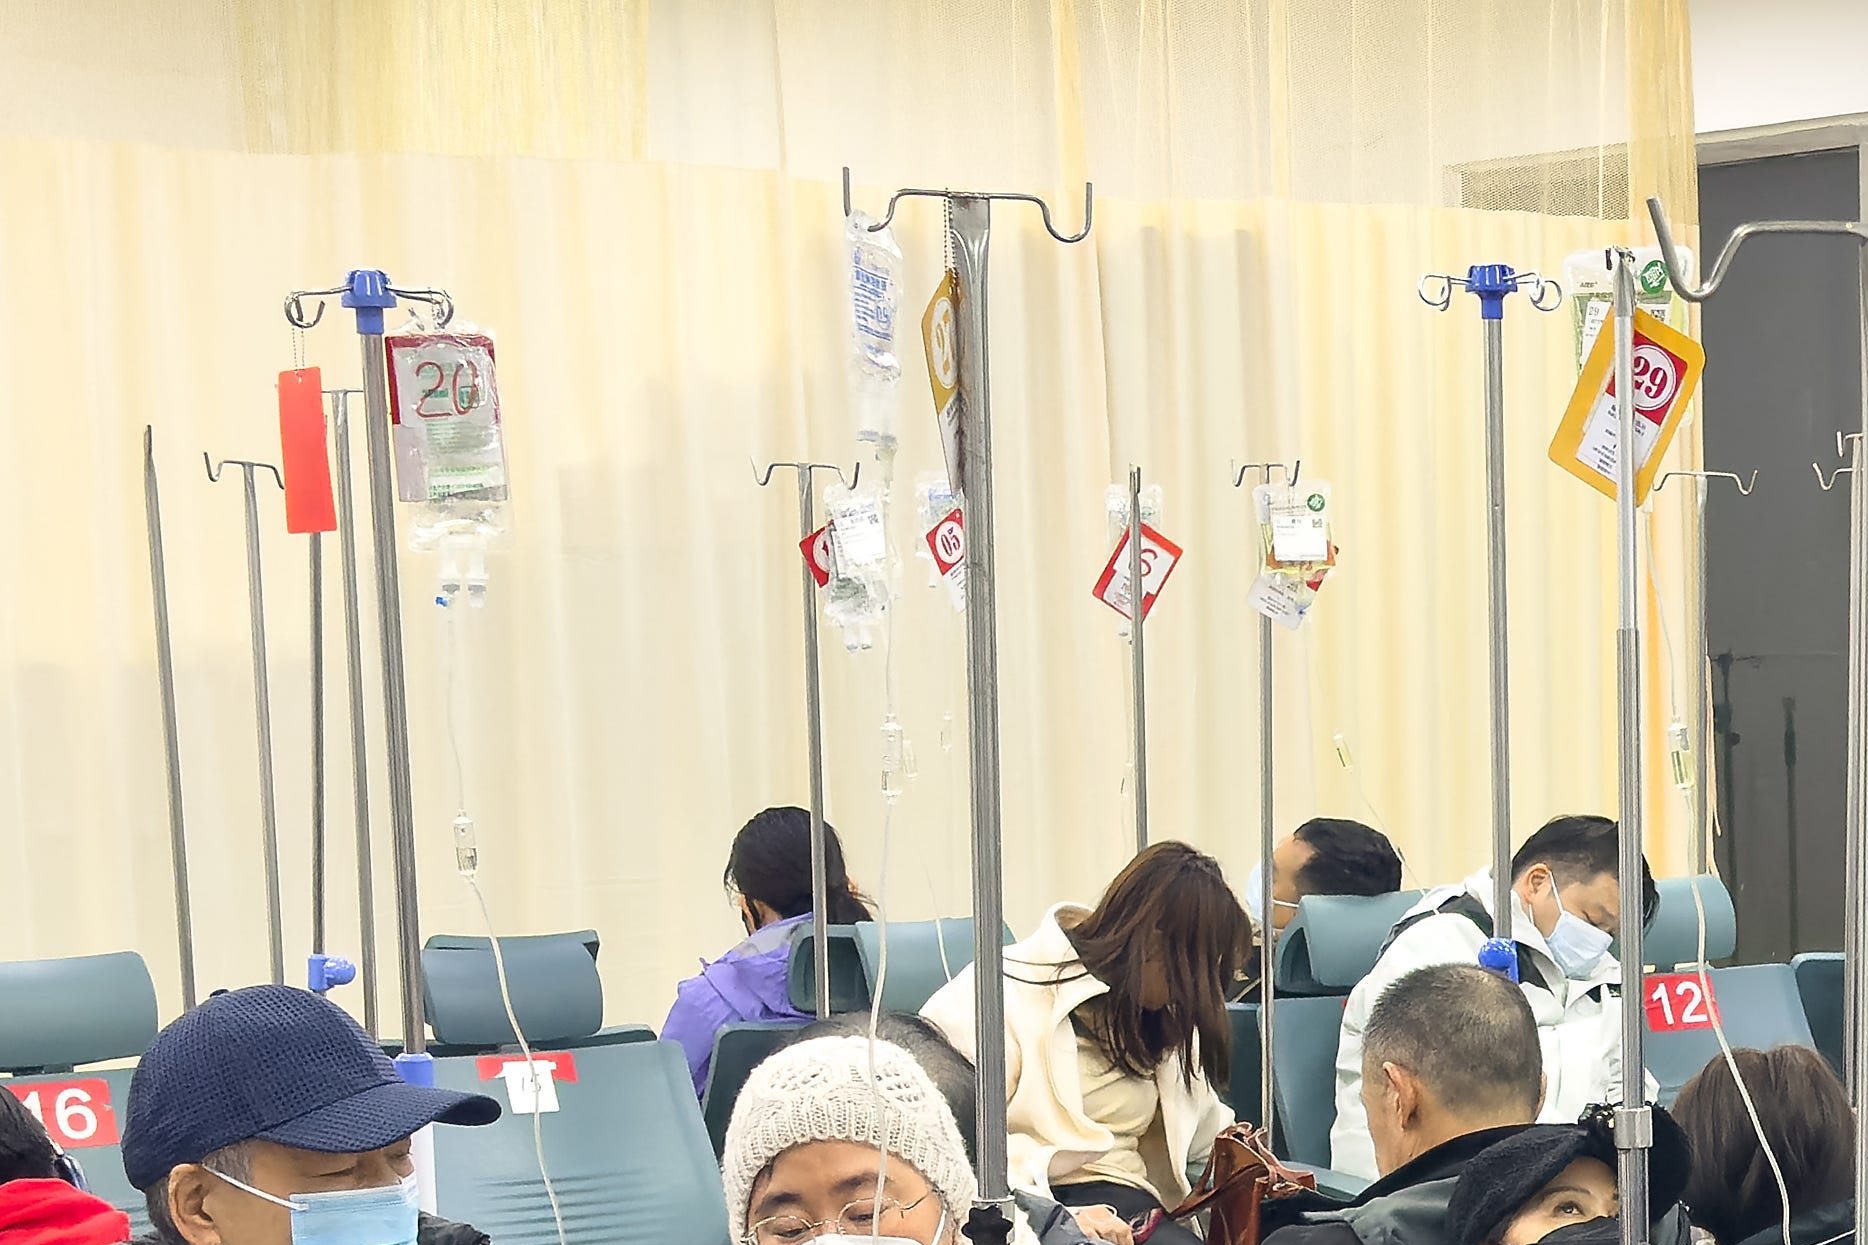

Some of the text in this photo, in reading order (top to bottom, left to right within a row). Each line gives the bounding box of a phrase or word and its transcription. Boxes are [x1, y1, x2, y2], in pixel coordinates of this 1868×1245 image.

[415, 360, 479, 418] 20
[1634, 355, 1669, 399] 29
[1651, 981, 1708, 1025] 12
[22, 1088, 98, 1140] 16
